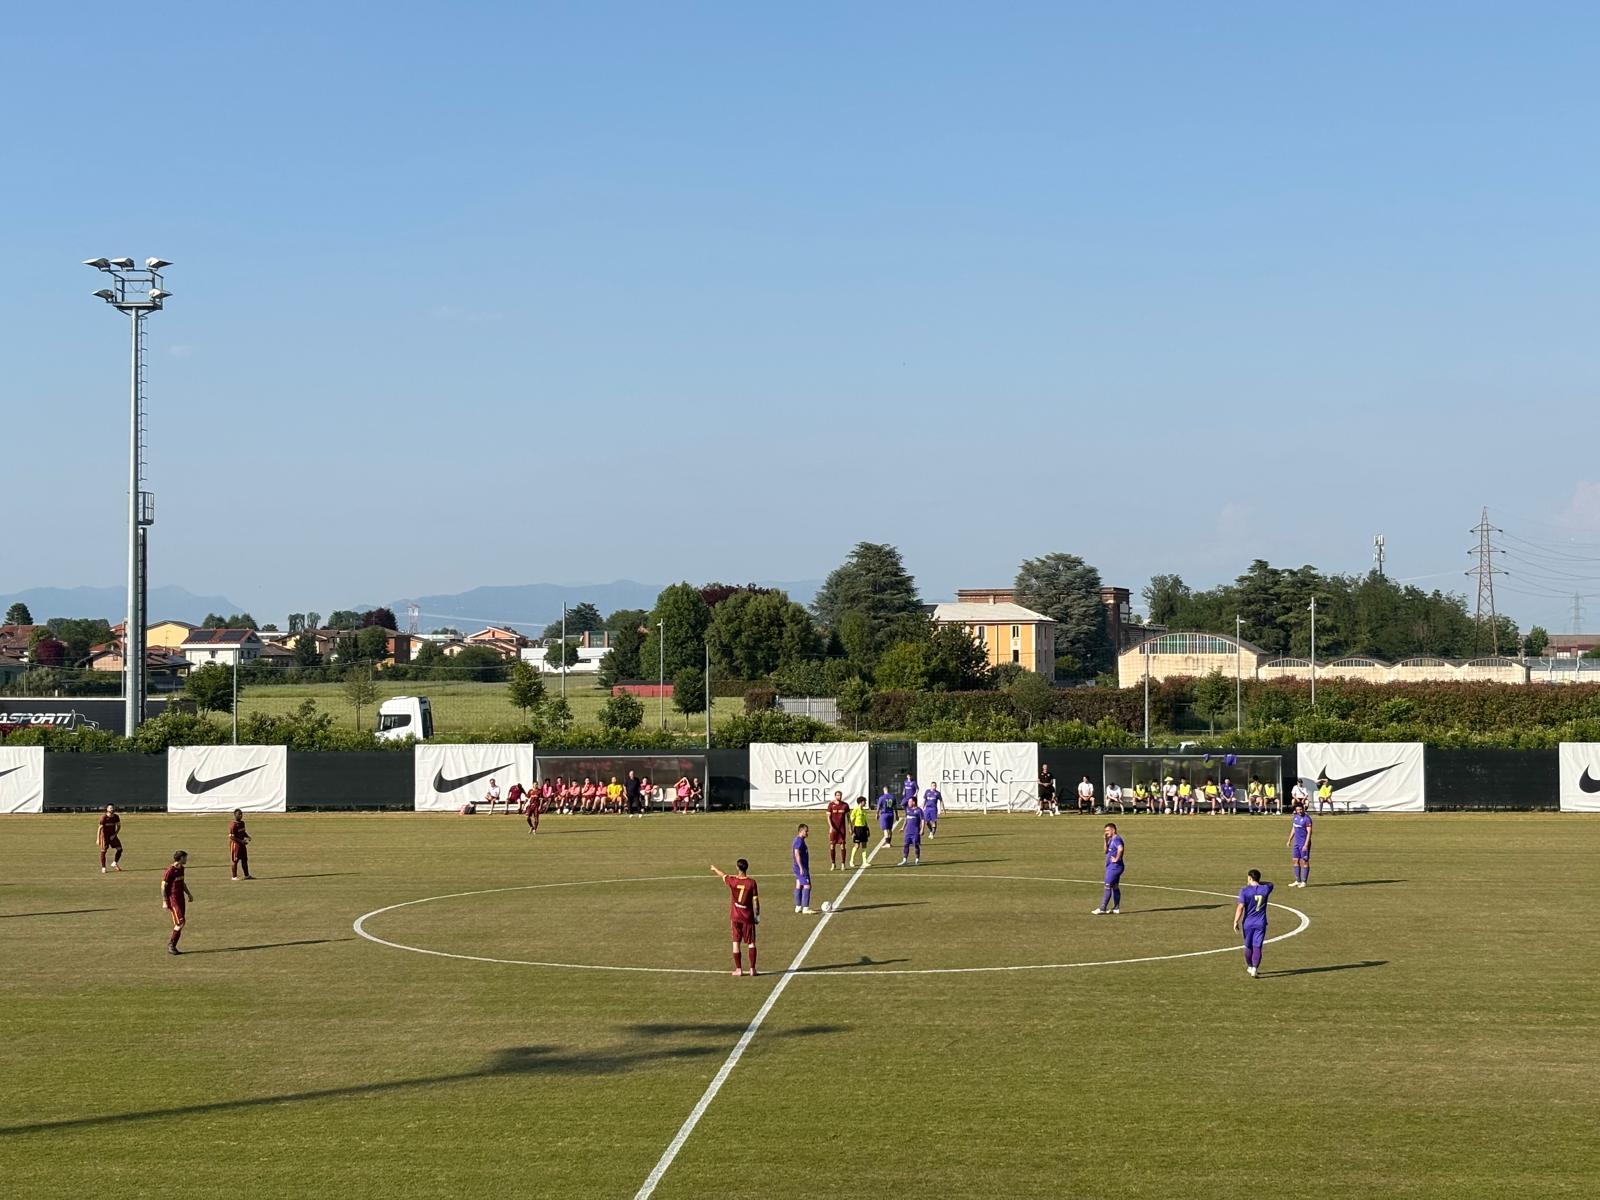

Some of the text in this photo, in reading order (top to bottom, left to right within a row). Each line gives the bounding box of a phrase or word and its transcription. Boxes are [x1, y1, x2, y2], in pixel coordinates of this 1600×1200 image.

[796, 751, 823, 765] WE
[964, 751, 991, 765] WE
[775, 769, 845, 784] BELONG
[942, 769, 1013, 784] BELONG
[788, 788, 830, 803] HERE
[956, 788, 999, 803] HERE
[736, 885, 745, 902] 7
[1254, 895, 1263, 911] 7
